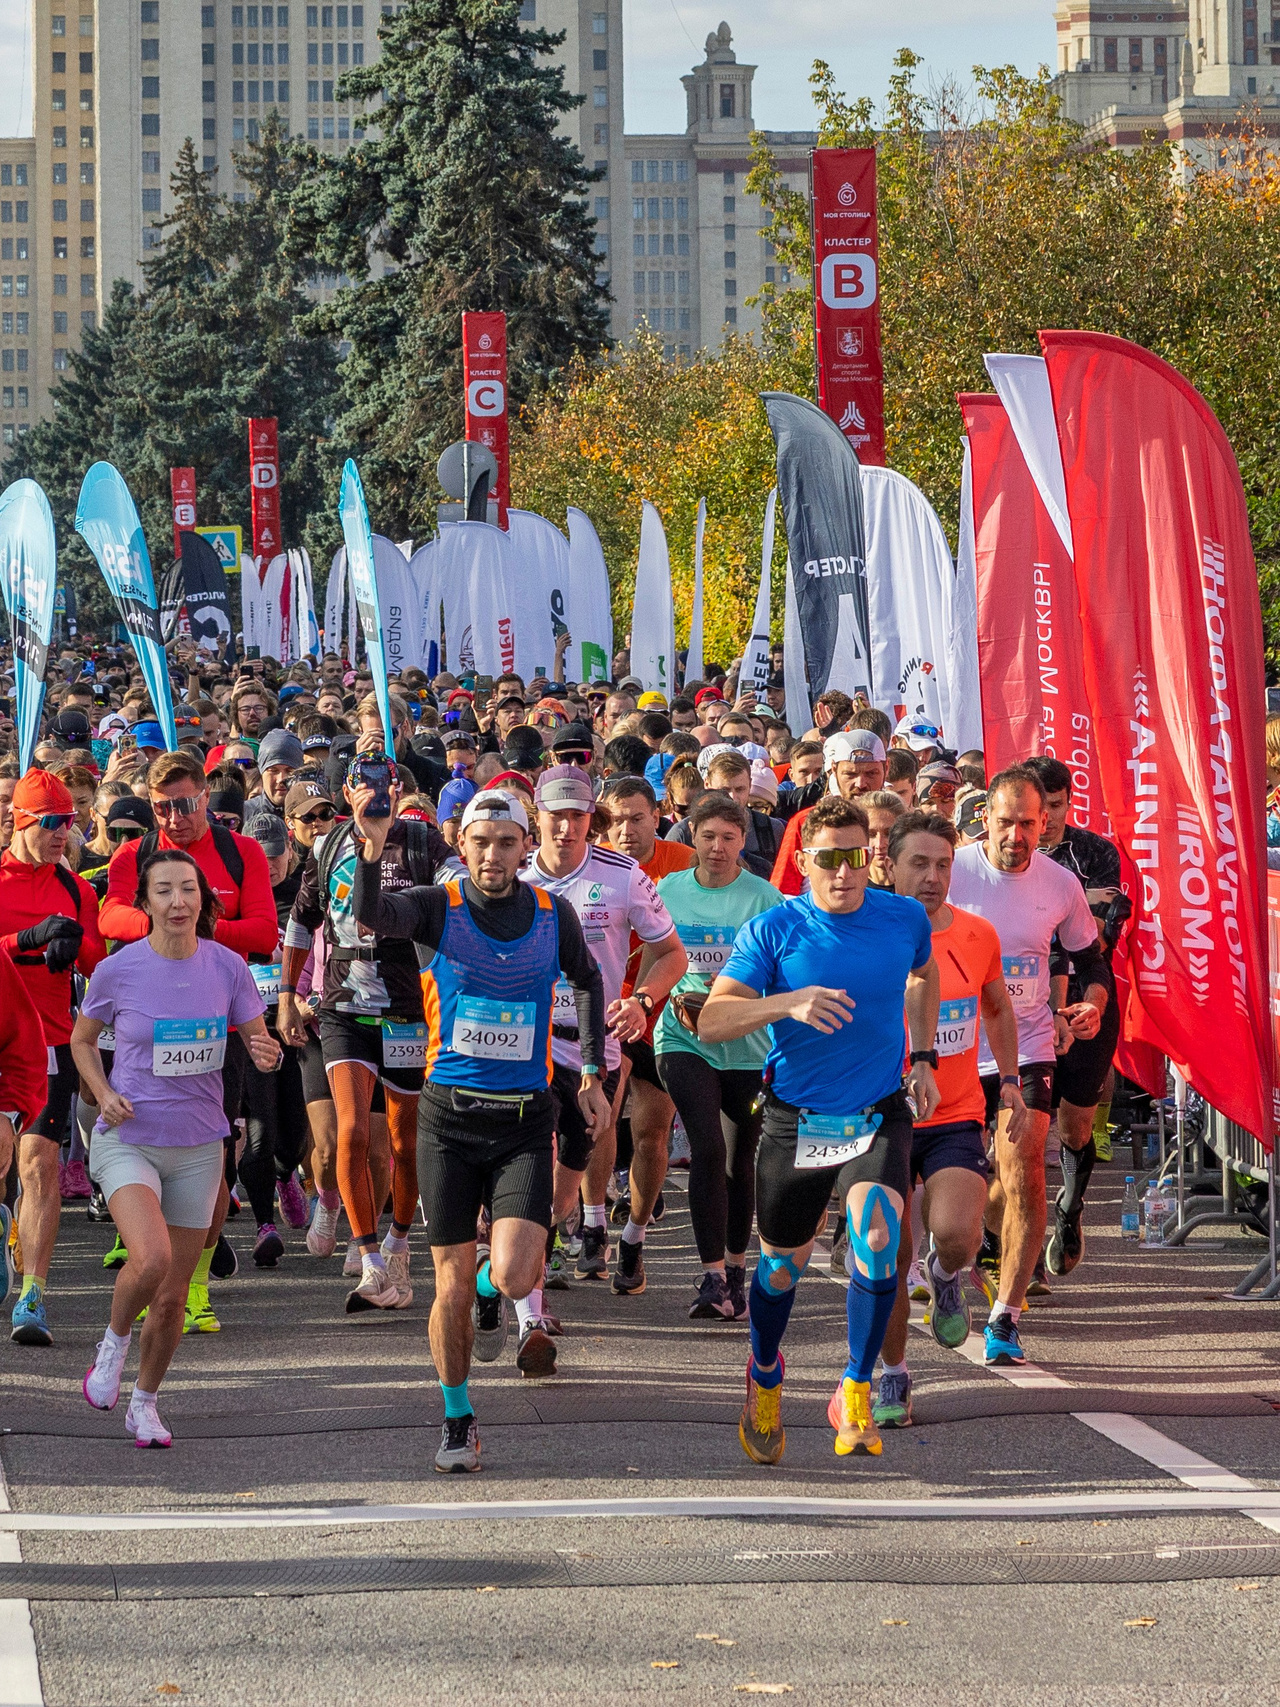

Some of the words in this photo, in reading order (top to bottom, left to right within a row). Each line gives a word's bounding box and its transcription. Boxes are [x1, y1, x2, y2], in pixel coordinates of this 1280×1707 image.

[839, 211, 871, 219] СТОЛИЦА
[824, 238, 872, 246] КЛАСТЕР
[833, 264, 865, 298] B
[474, 386, 496, 410] C
[258, 468, 273, 484] D
[181, 509, 190, 521] E
[388, 606, 404, 674] Медиа
[381, 860, 398, 870] бег
[380, 877, 413, 890] район
[581, 911, 609, 921] INEOS
[259, 983, 280, 997] 314
[461, 1028, 519, 1048] 24092
[934, 1027, 965, 1045] 4107
[162, 1047, 214, 1065] 24047
